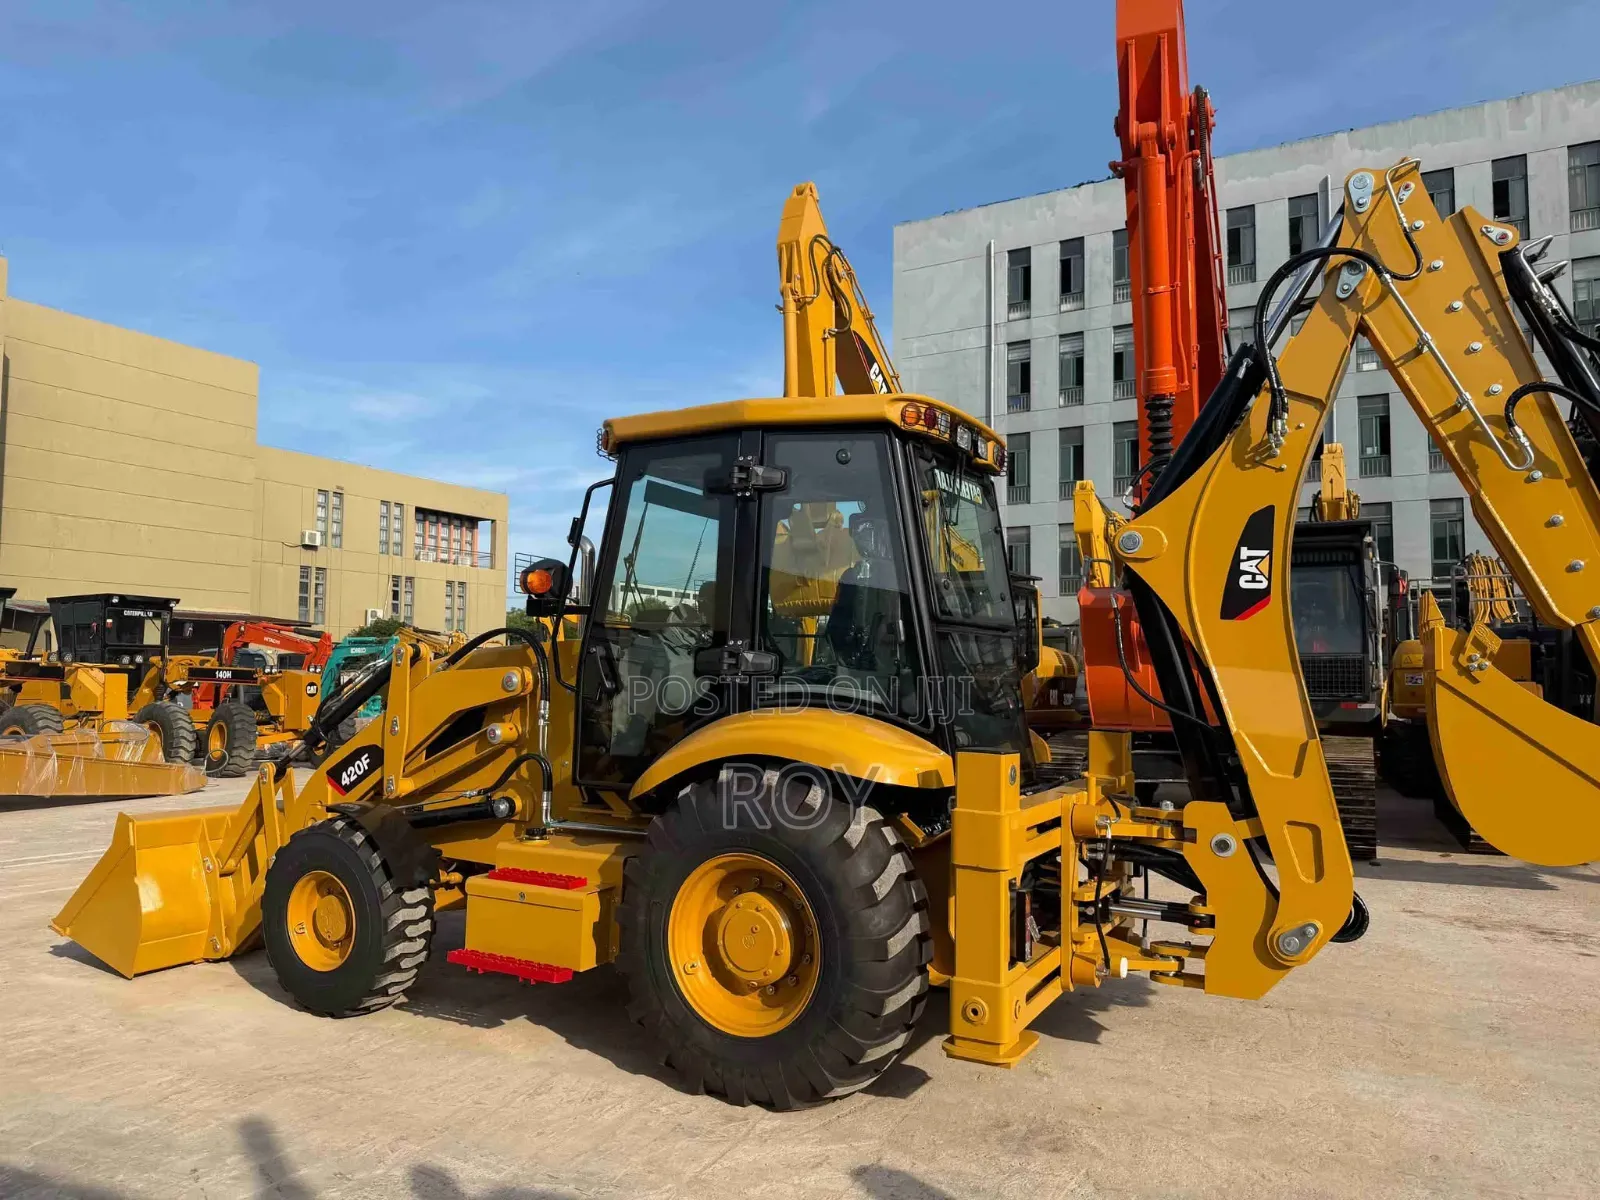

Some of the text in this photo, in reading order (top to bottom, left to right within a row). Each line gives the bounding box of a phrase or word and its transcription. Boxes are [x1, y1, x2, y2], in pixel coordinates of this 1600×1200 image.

[1239, 546, 1270, 590] CAT
[215, 670, 232, 679] 140H
[306, 685, 317, 694] CAT
[341, 752, 371, 786] 420F
